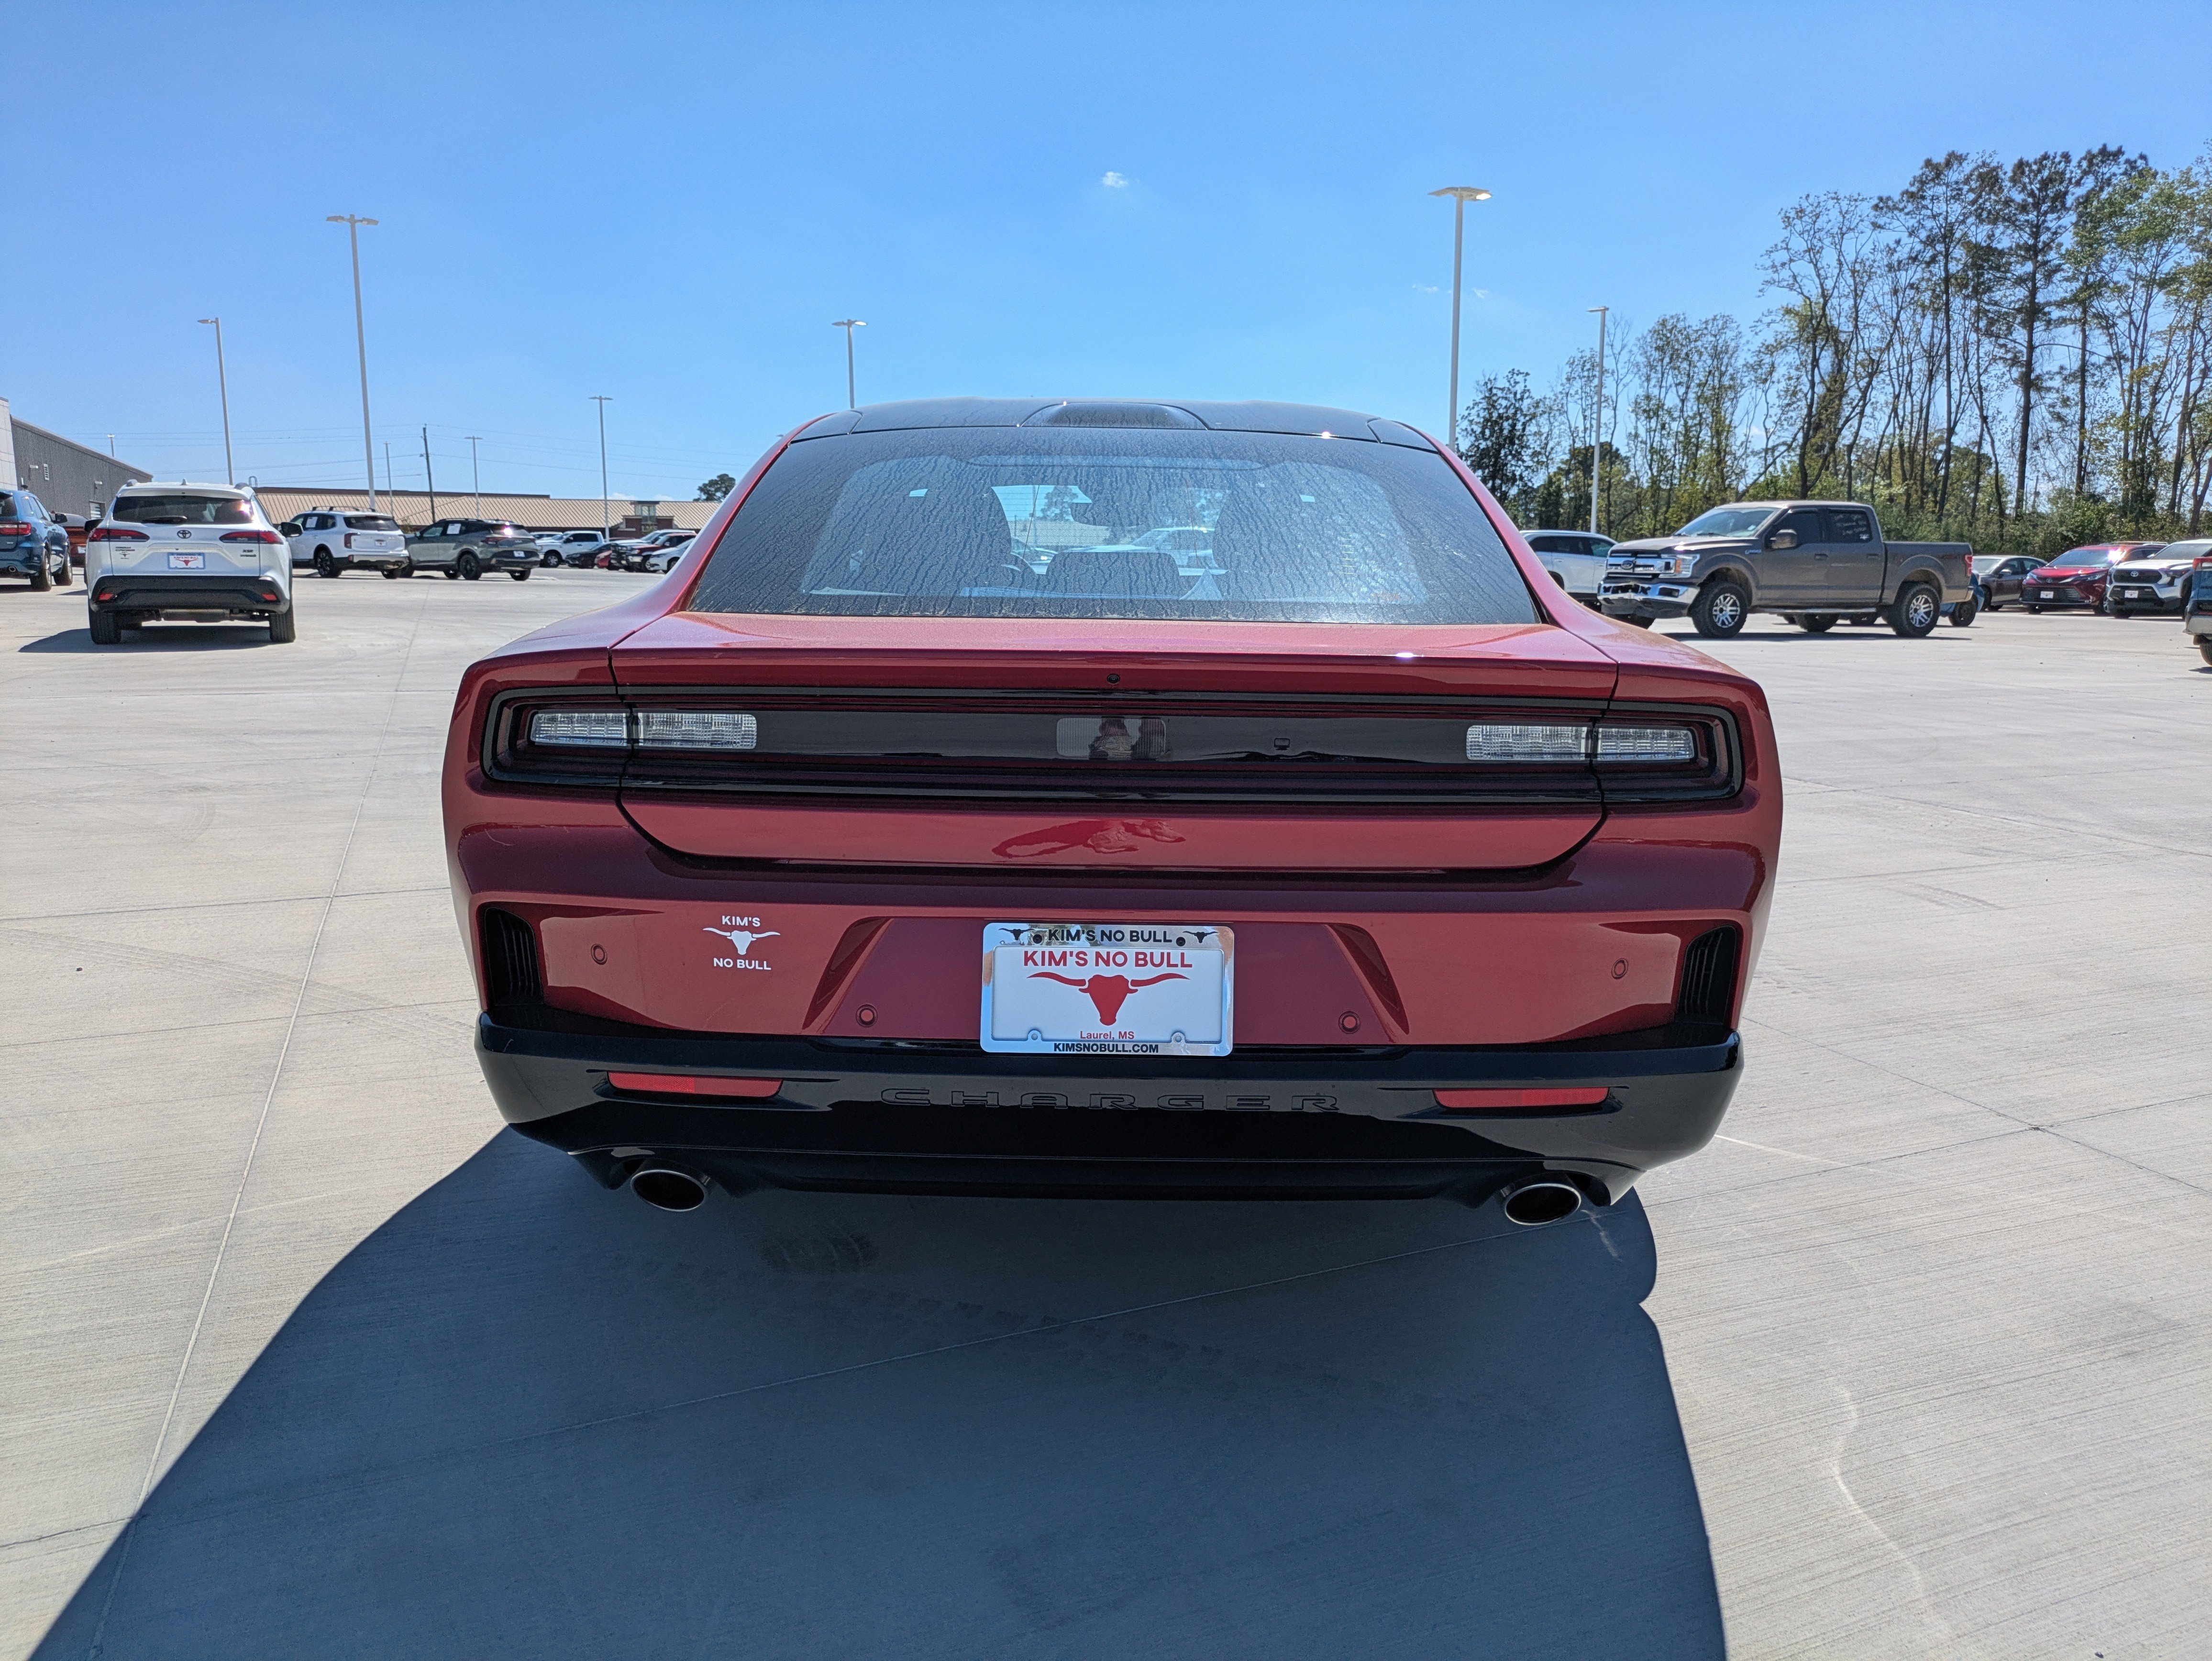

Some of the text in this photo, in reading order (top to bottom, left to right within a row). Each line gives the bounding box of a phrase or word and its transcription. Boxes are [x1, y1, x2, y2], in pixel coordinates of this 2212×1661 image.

[722, 915, 761, 927] KIM'S
[1048, 929, 1172, 943] KIM'S NO BULL
[713, 957, 771, 970] NO BULL
[1024, 951, 1193, 968] KIM'S NO BULL
[1080, 1030, 1134, 1041] Laurel, MS
[1053, 1042, 1159, 1053] KIMSNOBULL.COM
[881, 1088, 1340, 1112] CHARGER
